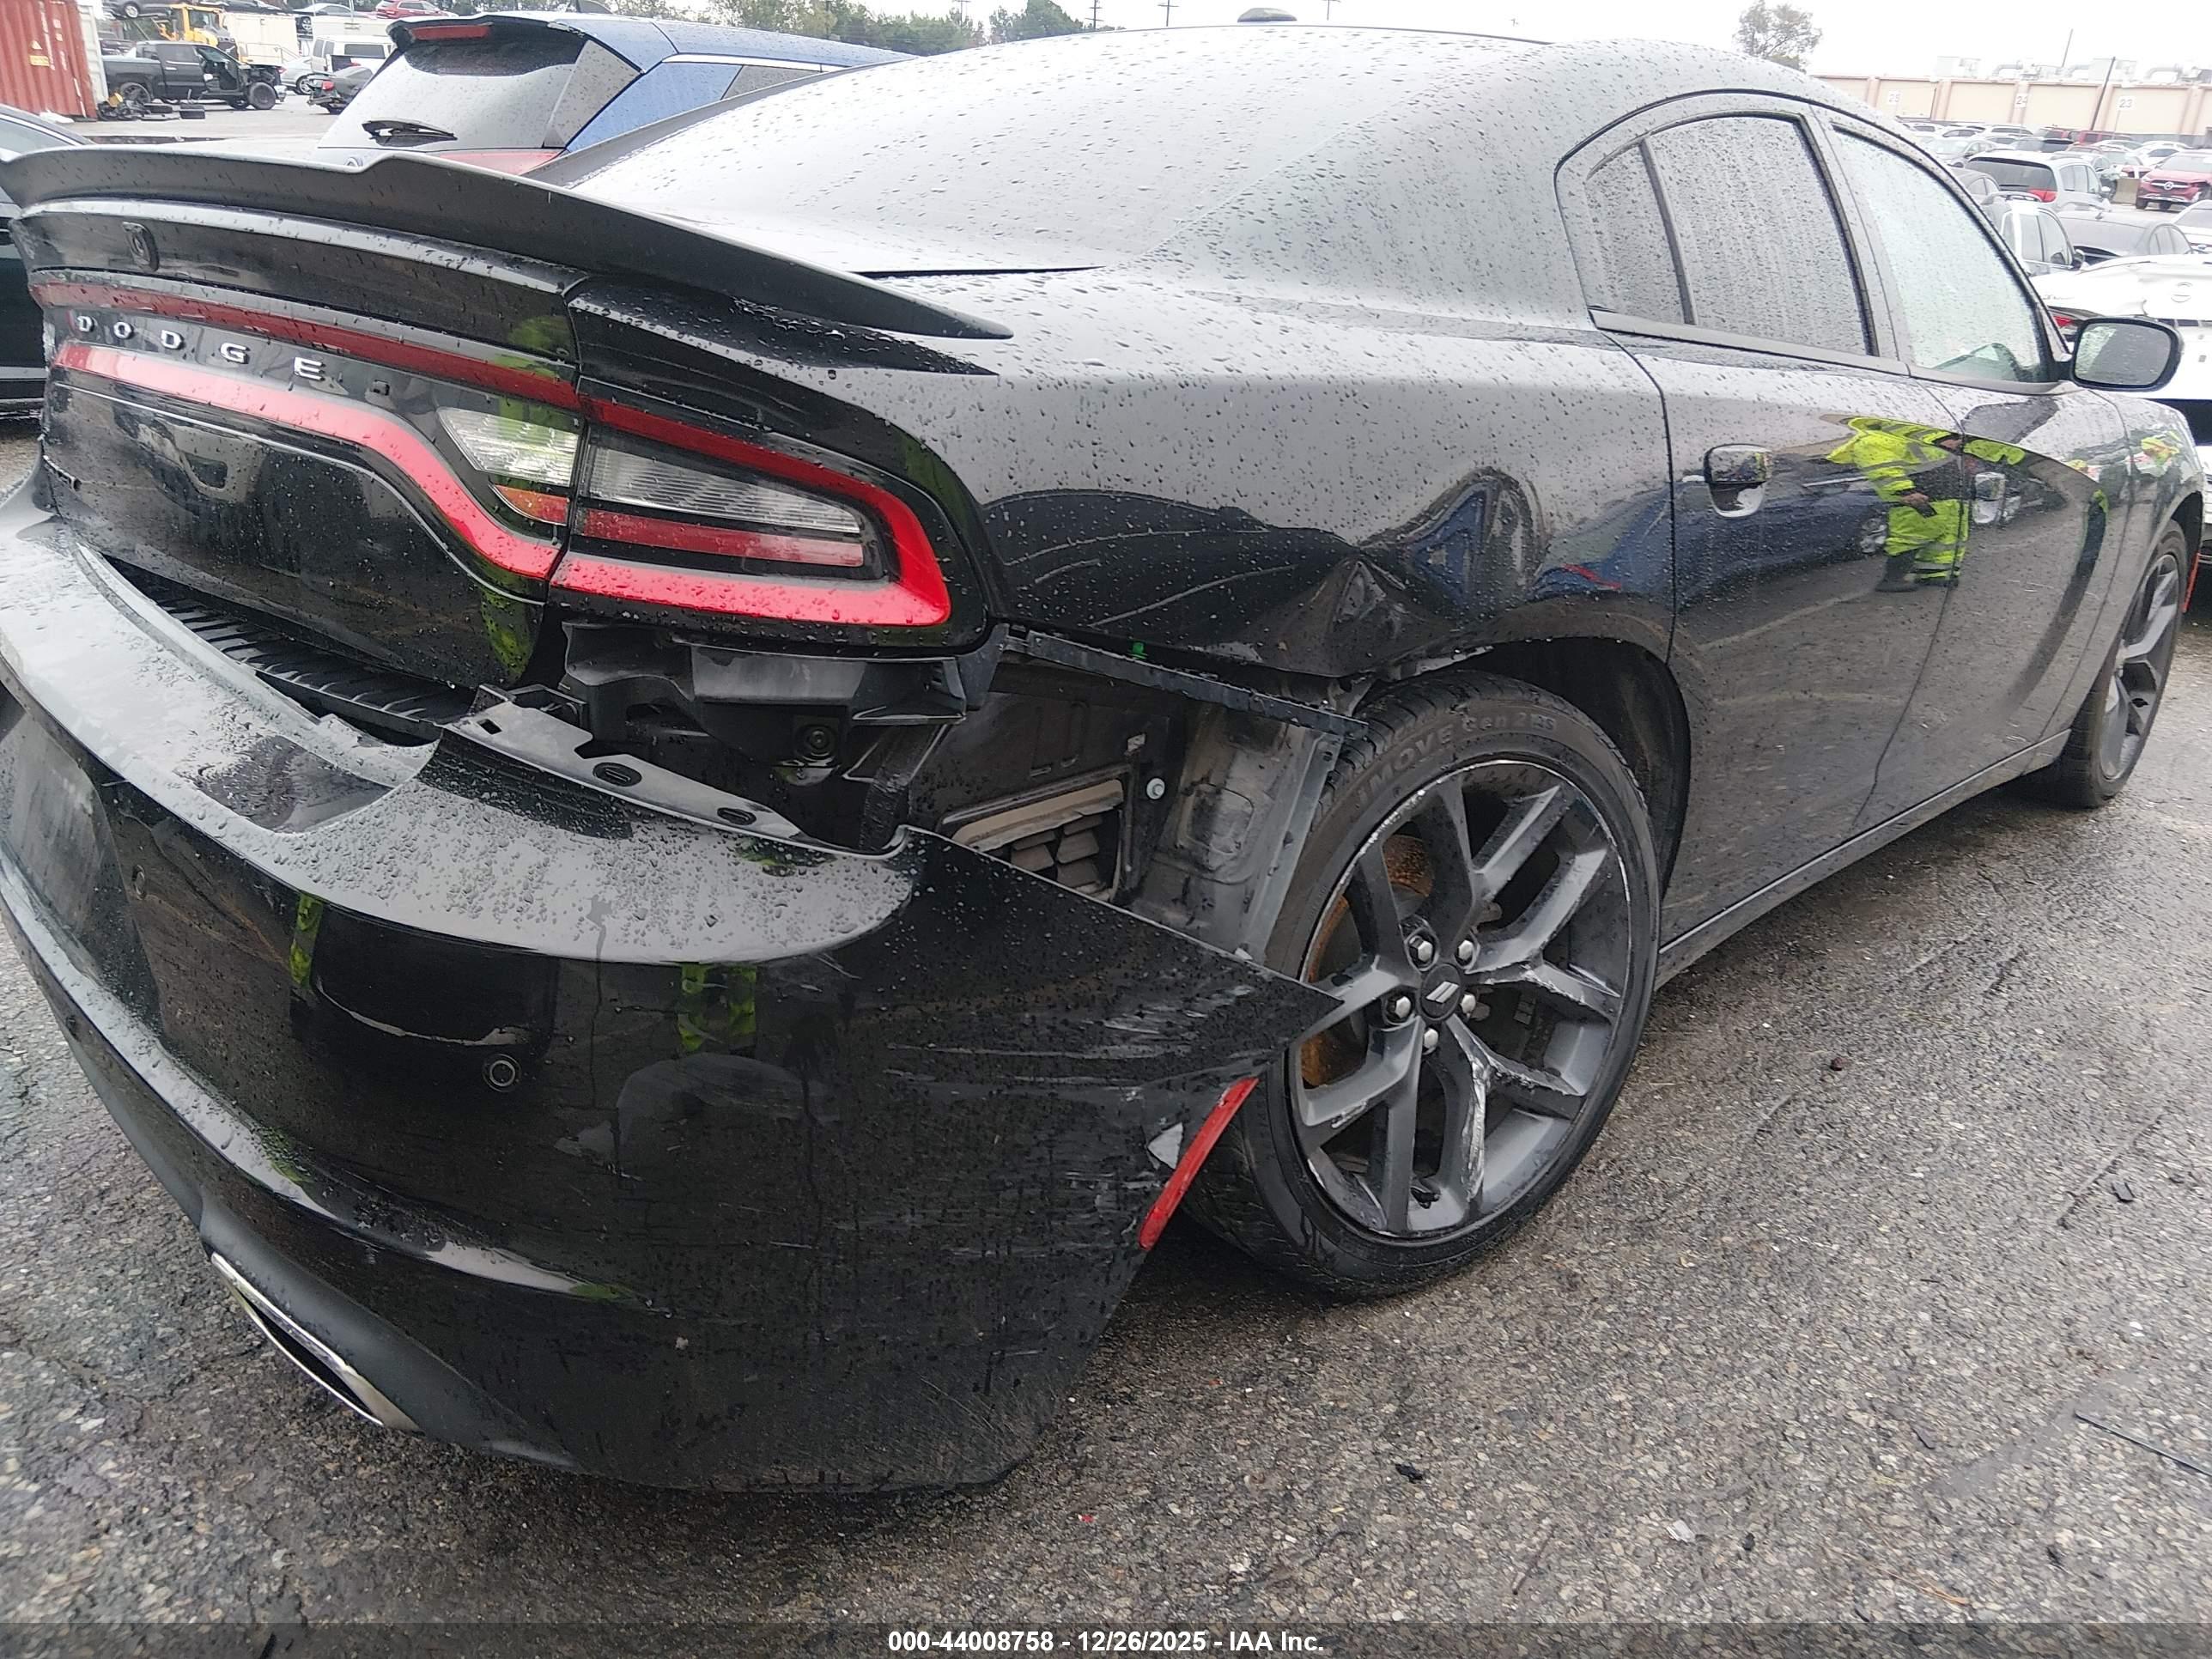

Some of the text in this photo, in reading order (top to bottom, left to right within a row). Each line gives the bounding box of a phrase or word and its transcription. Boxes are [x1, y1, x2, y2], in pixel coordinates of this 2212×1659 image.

[2015, 95, 2028, 106] 24
[2118, 99, 2133, 108] 23
[76, 315, 326, 381] DODGE
